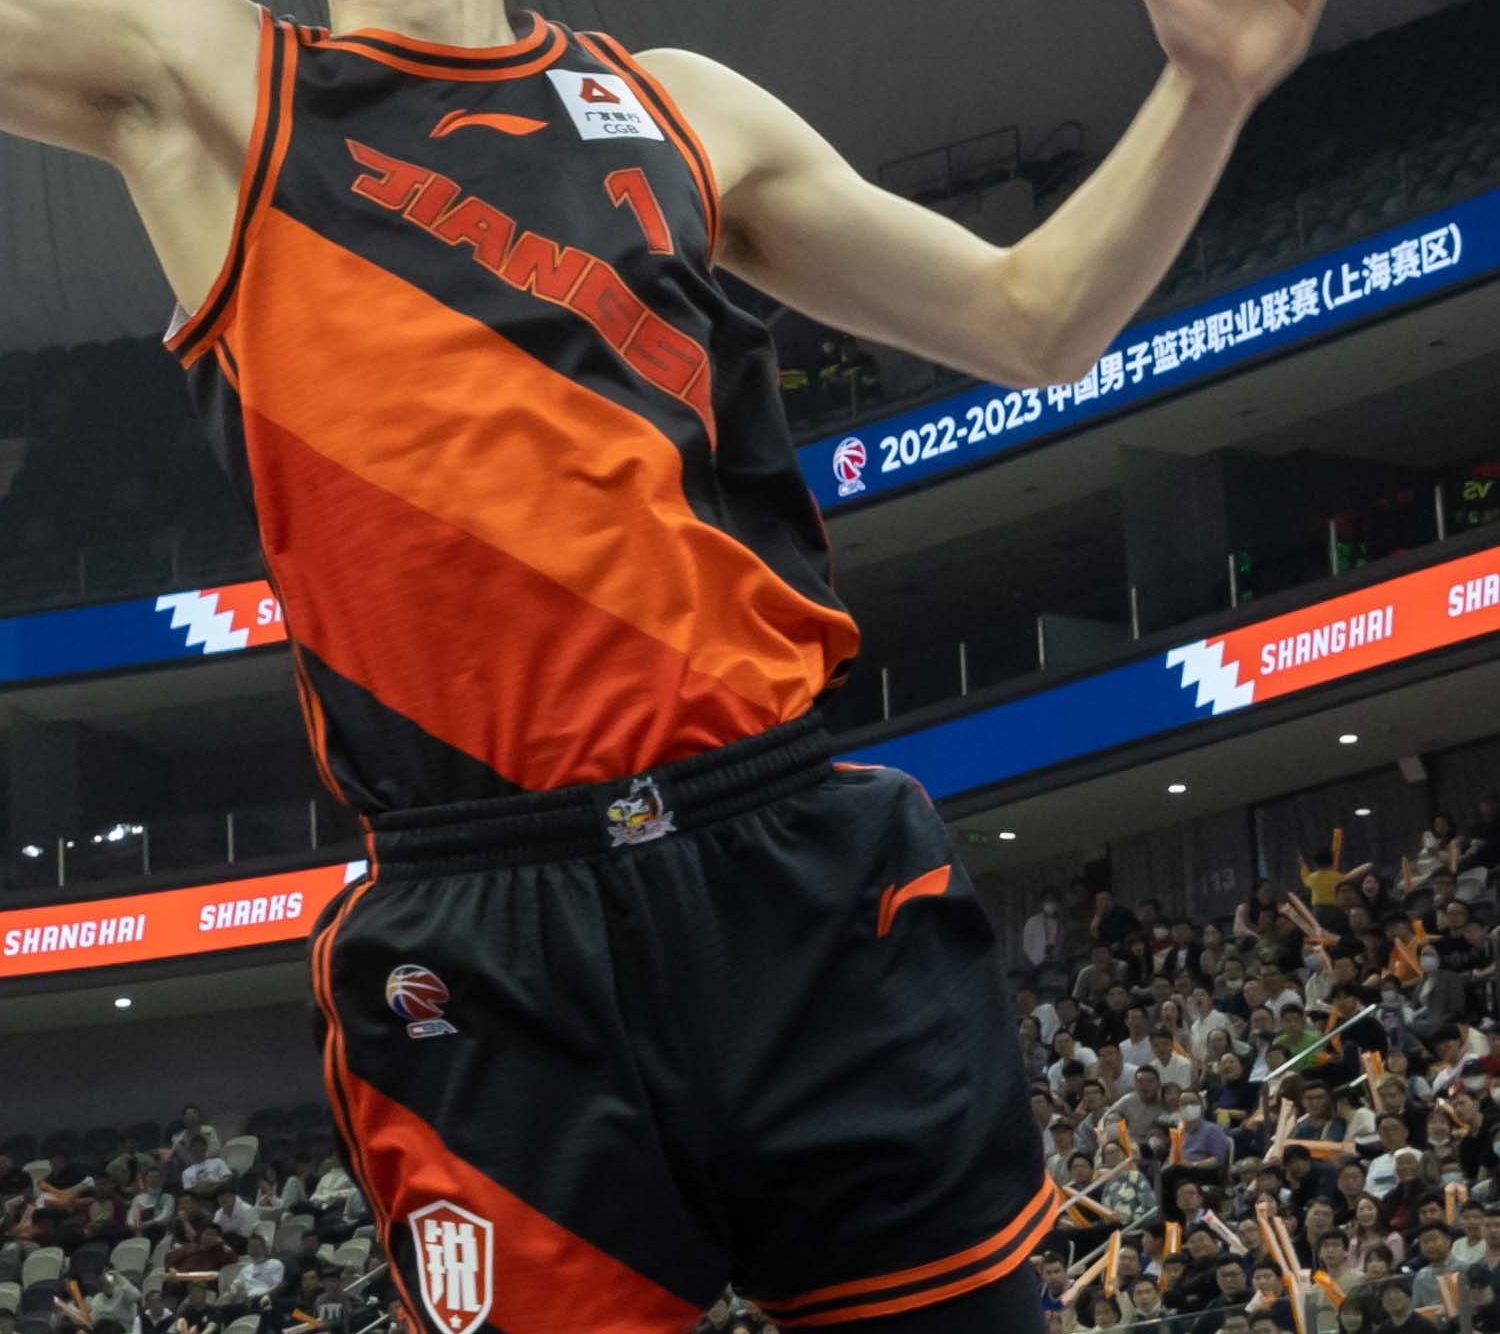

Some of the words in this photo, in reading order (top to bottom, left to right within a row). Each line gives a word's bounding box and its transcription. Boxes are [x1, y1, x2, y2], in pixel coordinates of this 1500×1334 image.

[603, 123, 640, 135] CGB
[605, 167, 674, 256] 1
[345, 137, 718, 452] JIANGS
[880, 386, 1043, 472] 2022-2023
[1260, 604, 1393, 677] SHANGHAI
[3, 913, 145, 957] SHANGHAI
[199, 892, 303, 932] SHARKS
